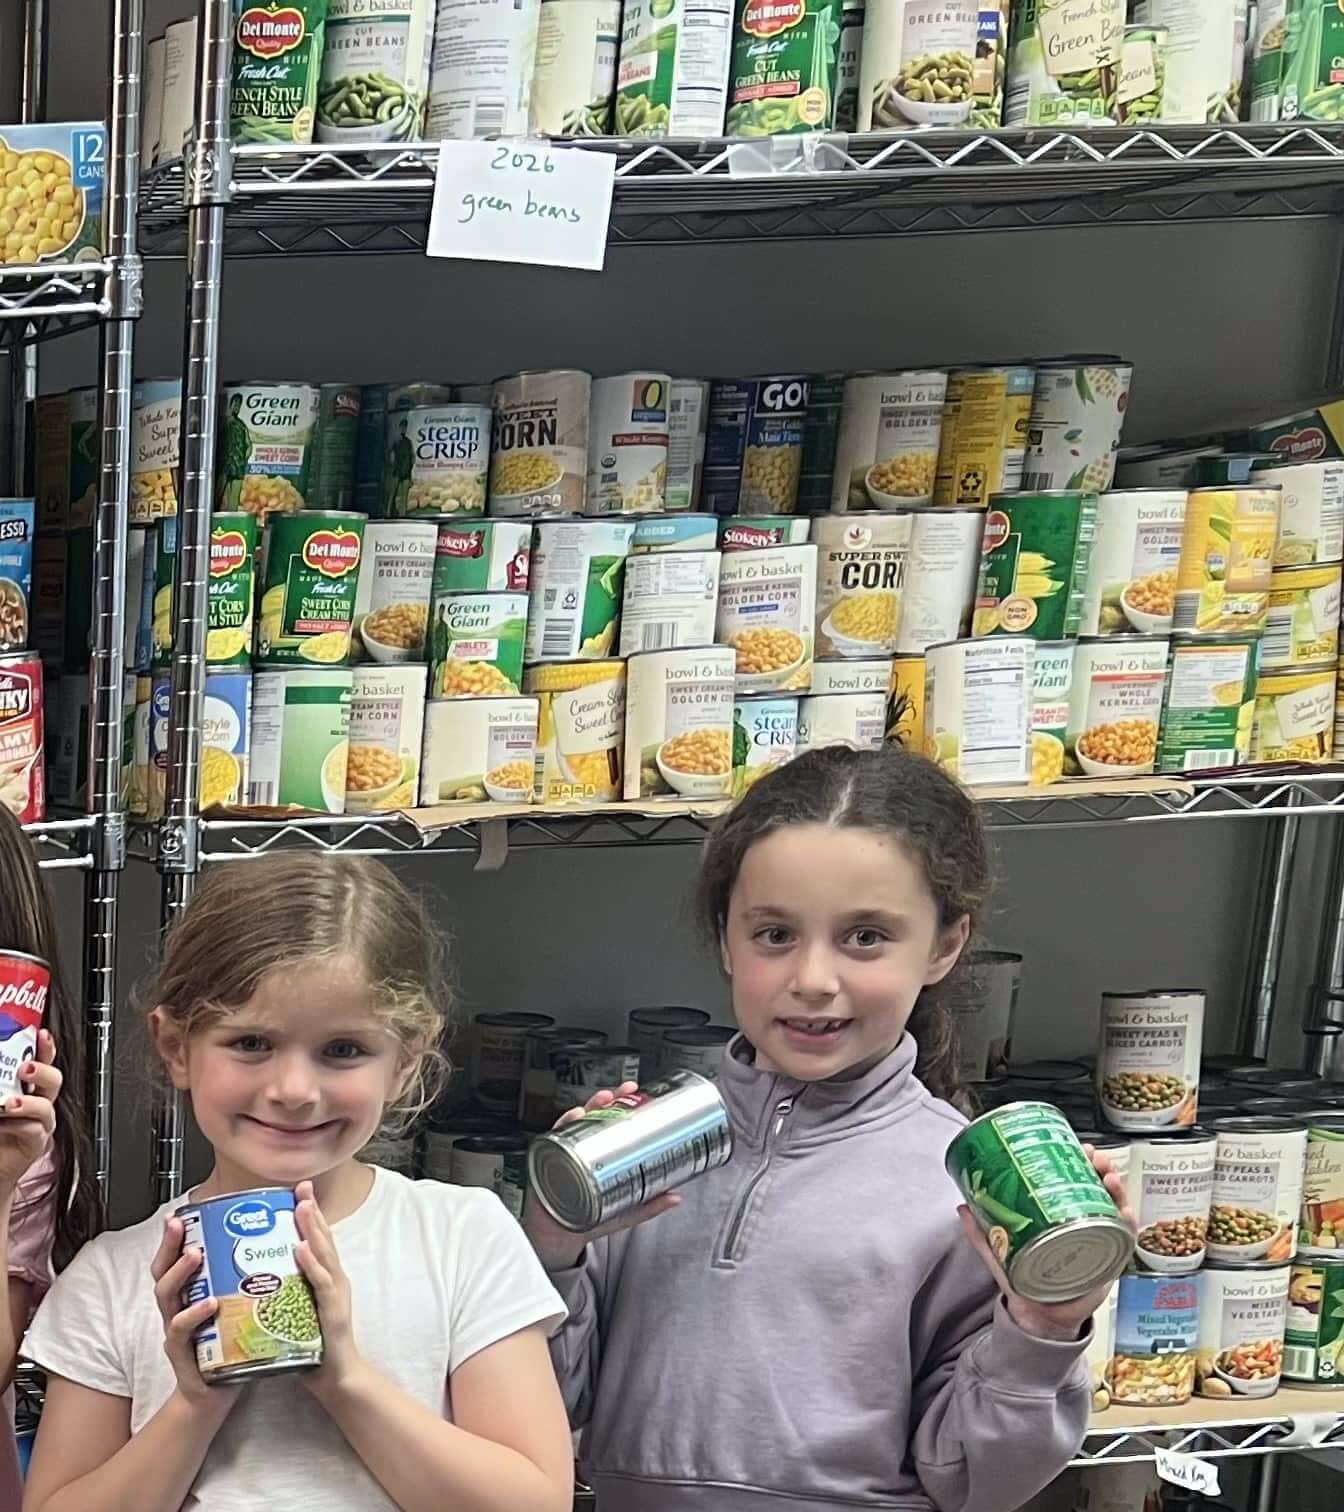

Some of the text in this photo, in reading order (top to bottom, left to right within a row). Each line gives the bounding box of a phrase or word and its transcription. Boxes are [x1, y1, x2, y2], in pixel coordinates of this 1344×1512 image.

[763, 4, 801, 20] Monte
[242, 21, 300, 36] Del Monte
[1048, 29, 1097, 58] Green
[754, 60, 776, 73] CUT
[735, 70, 801, 88] GREEN BEANS
[269, 86, 303, 101] STYLE
[79, 134, 104, 162] 12
[490, 148, 556, 174] 2026
[461, 190, 582, 224] green beans
[245, 393, 300, 410] Green
[250, 409, 300, 427] Giant
[417, 424, 480, 443] steam
[416, 442, 478, 460] CRISP
[309, 543, 359, 558] Del Monte
[374, 542, 406, 553] bowl
[829, 551, 880, 563] SUPER
[762, 561, 804, 577] basket
[766, 591, 798, 604] CORN
[301, 599, 330, 611] SWEET
[447, 602, 491, 615] Green
[300, 610, 331, 620] CREAM
[451, 615, 490, 628] Giant
[665, 665, 699, 680] bowl
[1090, 660, 1123, 673] bowl
[362, 682, 405, 696] basket
[828, 676, 861, 690] bowl
[569, 699, 604, 716] Cream
[368, 711, 398, 721] CORN
[1146, 1012, 1189, 1025] basket
[1139, 1030, 1171, 1039] PEAS
[1136, 1039, 1184, 1048] CARROTS
[1240, 1148, 1282, 1160] basket
[1142, 1160, 1175, 1171] bowl
[244, 1247, 289, 1262] Sweet
[1223, 1285, 1256, 1297] bowl
